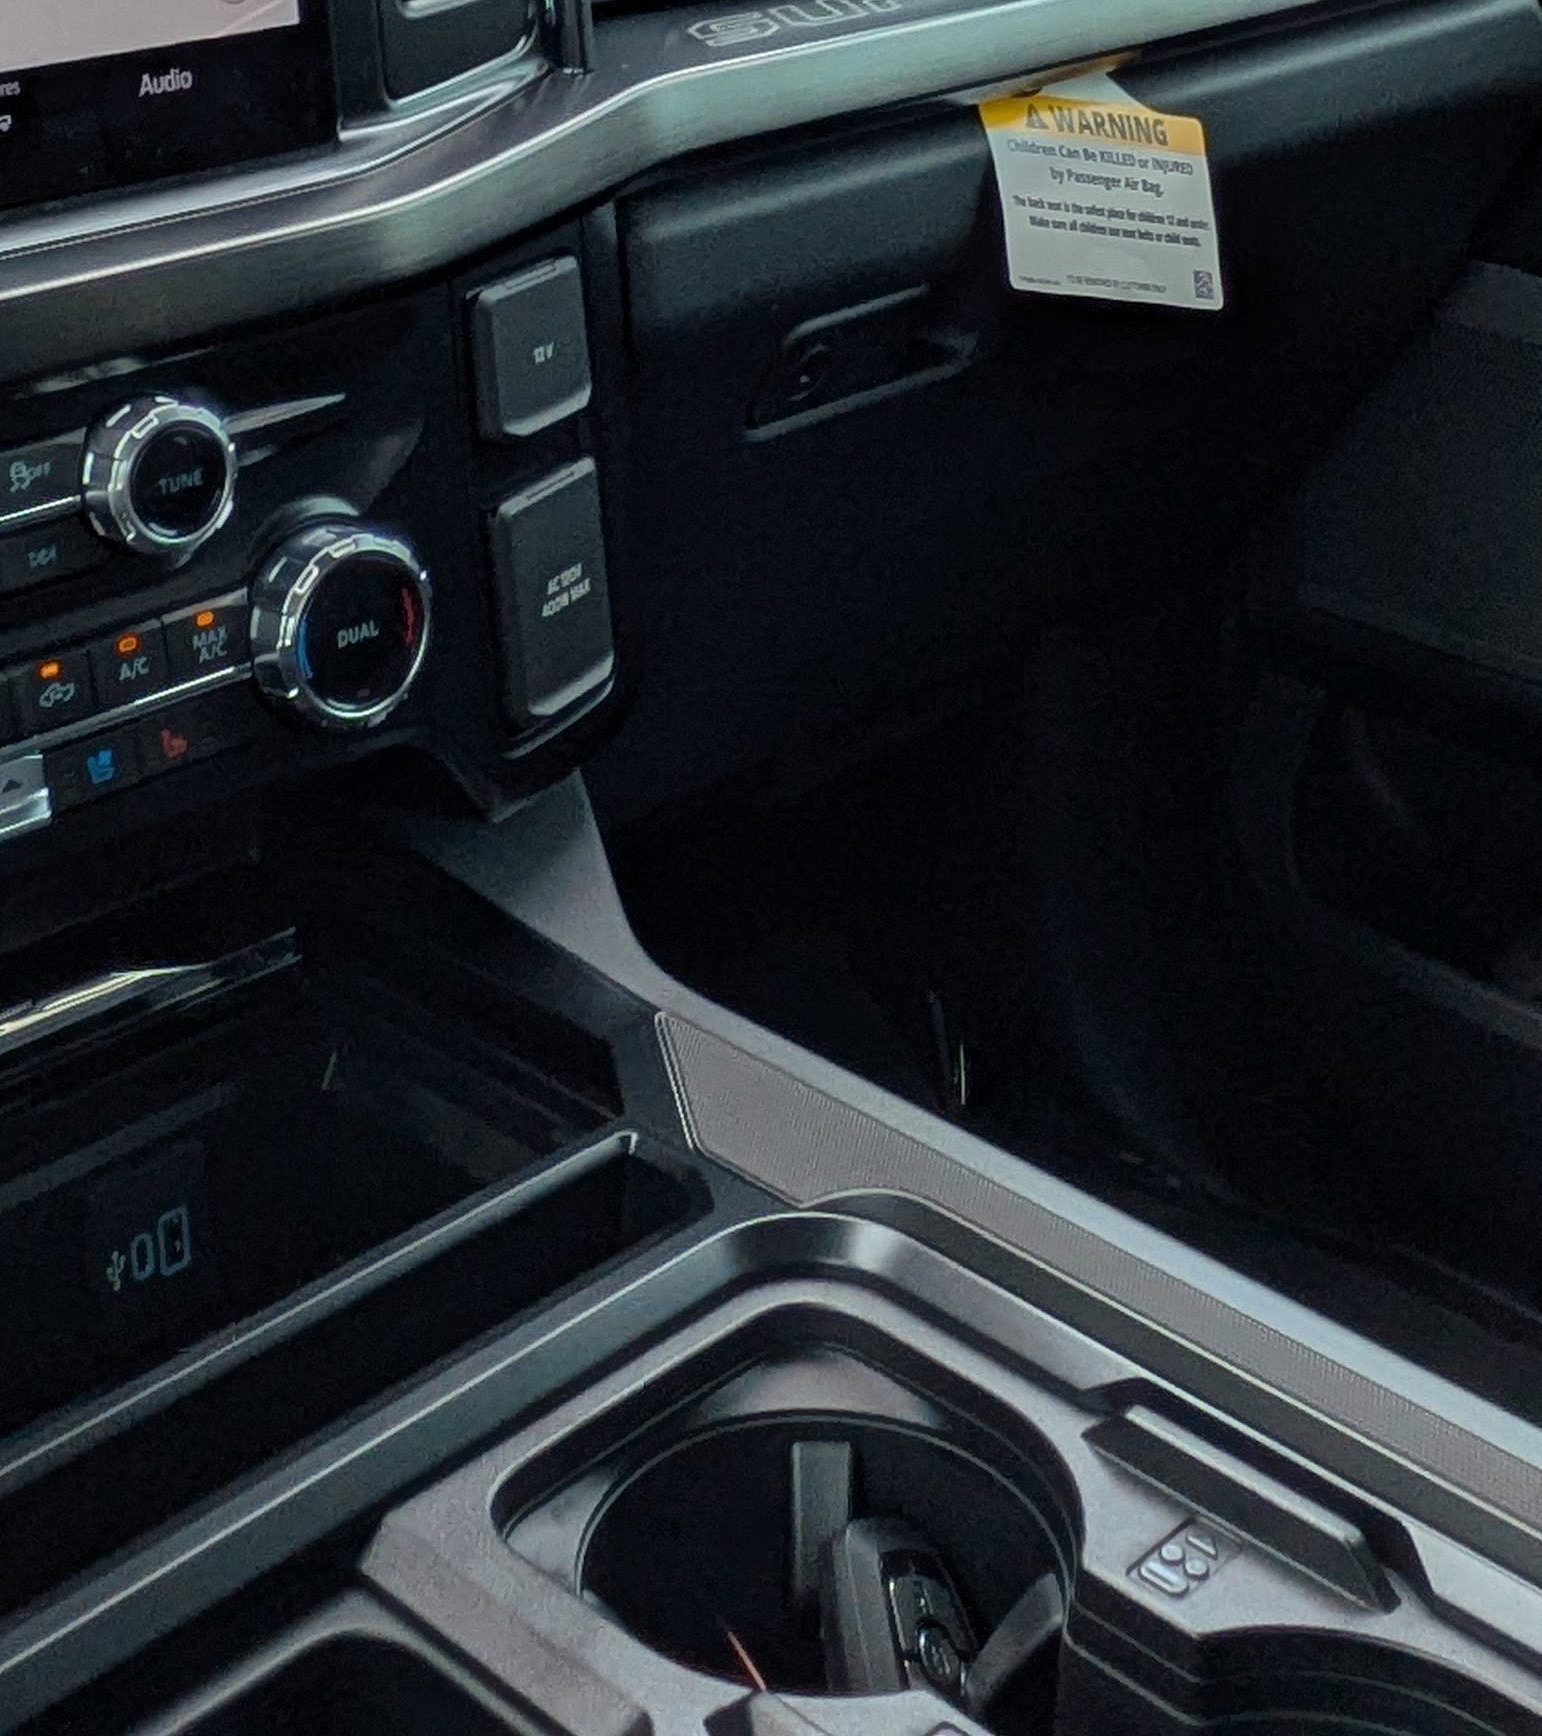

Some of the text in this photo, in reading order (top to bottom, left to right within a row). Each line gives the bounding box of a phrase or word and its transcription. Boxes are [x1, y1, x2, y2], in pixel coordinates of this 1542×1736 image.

[139, 68, 192, 98] Audio
[1049, 104, 1168, 146] WARNING
[1008, 138, 1194, 176] Children Can Be KILLED or INJURED
[1049, 166, 1064, 185] by
[1066, 168, 1121, 191] Passenger
[1124, 177, 1139, 190] Air
[158, 467, 204, 496] TUNE
[192, 625, 227, 650] MAX
[337, 618, 380, 650] DUAL
[197, 642, 227, 664] A/C
[118, 657, 149, 683] A/C
